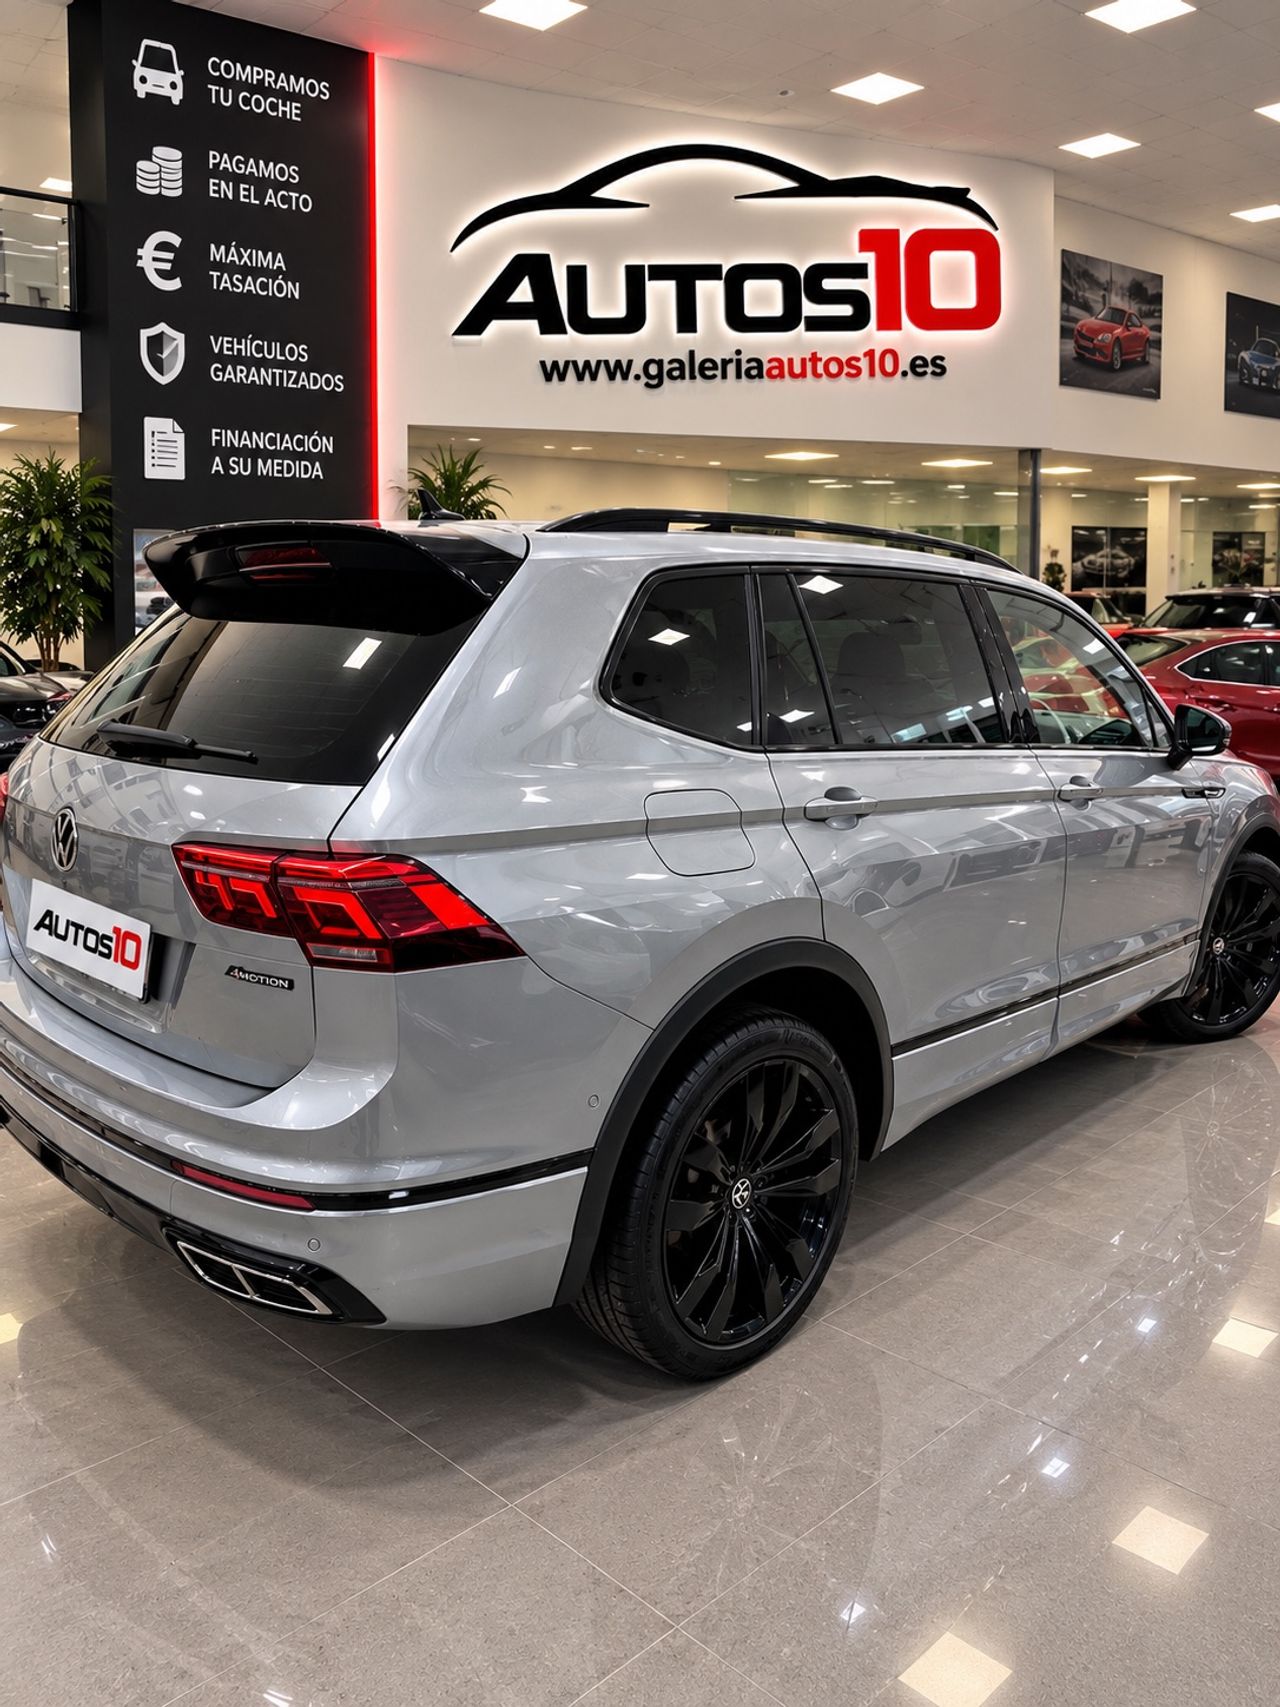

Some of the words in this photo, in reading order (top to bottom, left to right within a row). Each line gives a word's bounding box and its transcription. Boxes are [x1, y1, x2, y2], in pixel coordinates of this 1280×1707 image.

[208, 57, 329, 99] COMPRAMOS
[208, 85, 232, 106] TU
[239, 92, 301, 121] COCHE
[209, 151, 299, 183] PAGAMOS
[210, 179, 232, 200] EN
[240, 184, 259, 204] EL
[264, 189, 312, 212] ACTO
[209, 242, 286, 271] MÁXIMA
[209, 271, 299, 299] TASACIÓN
[210, 334, 308, 362] VEHÍCULOS
[210, 363, 344, 392] GARANTIZADOS
[539, 348, 947, 388] www.galeriaautos10.es
[211, 429, 333, 453] FINANCIACIÓN
[211, 456, 224, 474] A
[229, 457, 251, 476] SU
[258, 458, 323, 479] MEDIDA
[230, 968, 289, 989] 4MOTION
